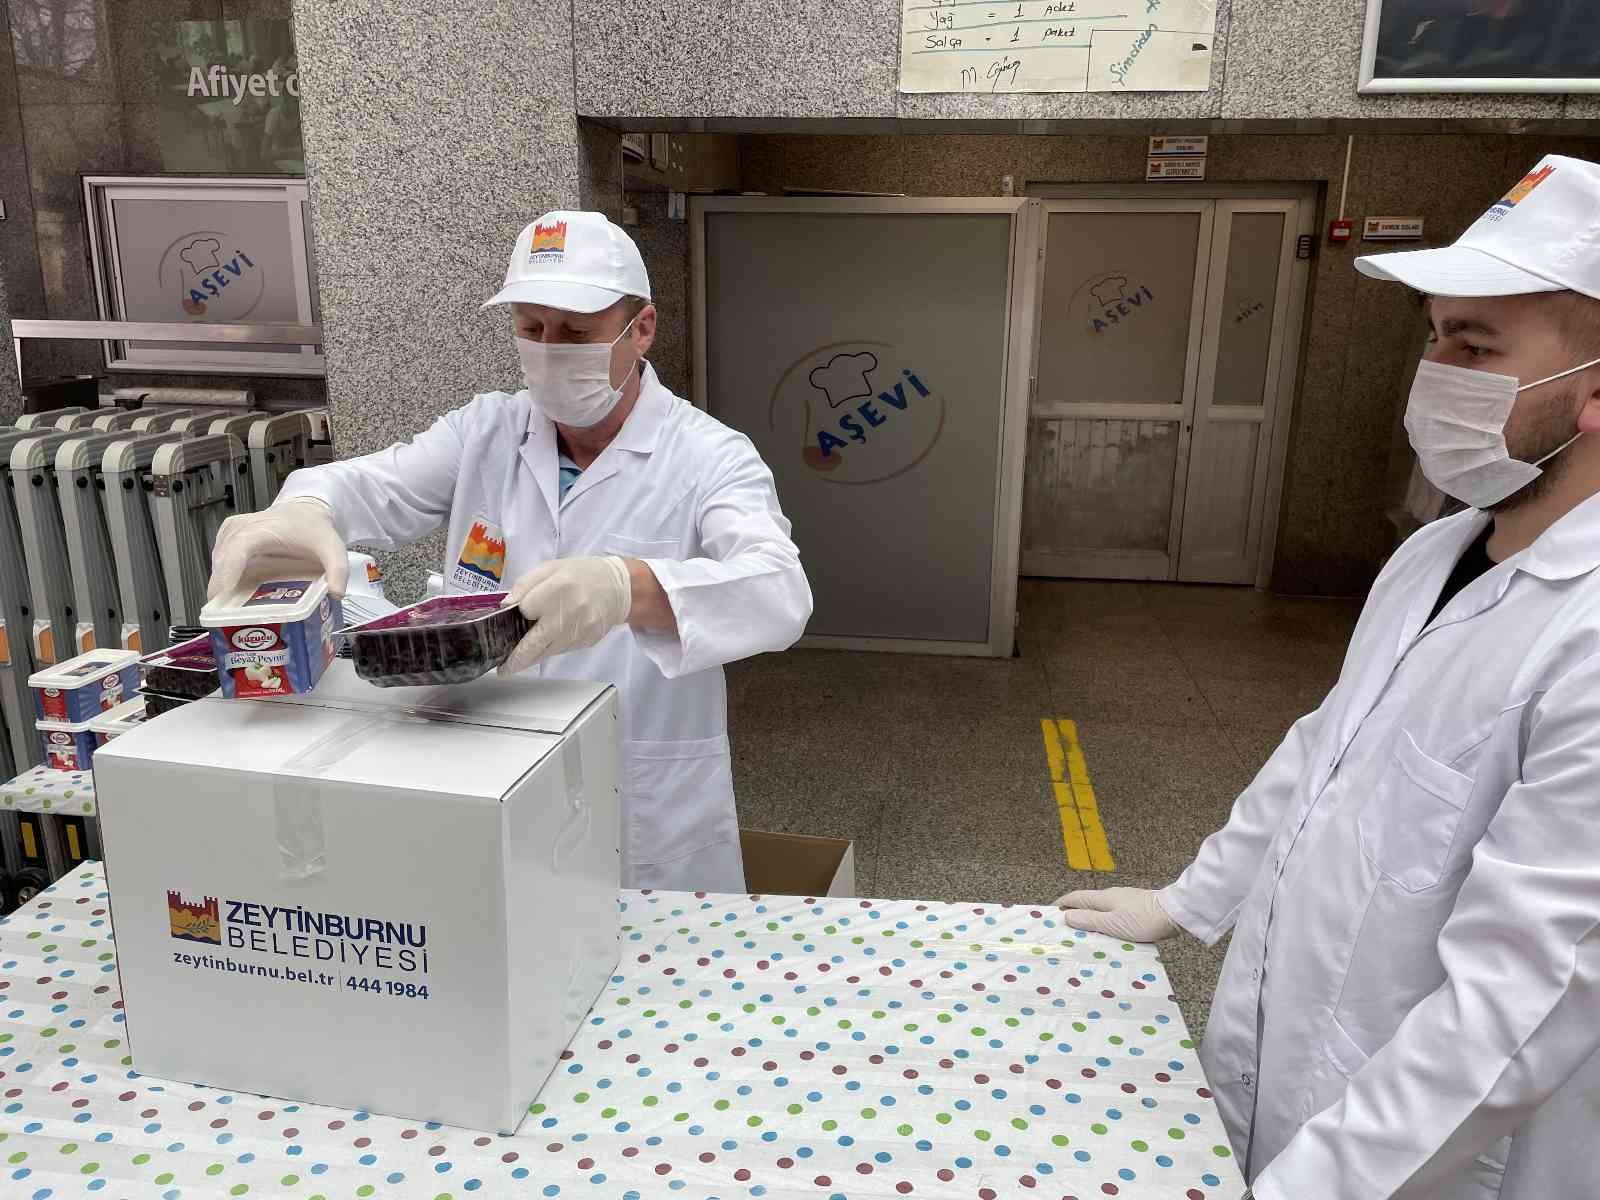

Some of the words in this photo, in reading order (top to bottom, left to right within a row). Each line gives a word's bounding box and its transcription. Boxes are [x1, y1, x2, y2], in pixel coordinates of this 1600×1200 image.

[924, 10, 954, 31] Yağ
[925, 35, 962, 49] Salça
[187, 64, 280, 106] Afiyet
[189, 249, 256, 305] AŞEVİ
[1091, 285, 1155, 333] AŞEVİ
[816, 368, 931, 459] AŞEVİ
[226, 900, 427, 948] ZEYTİNBURNU
[228, 926, 429, 973] BELEDİYESİ
[173, 952, 334, 986] zeytinburnu.bel.tr
[346, 976, 382, 994] 444
[385, 981, 430, 1000] 1984
